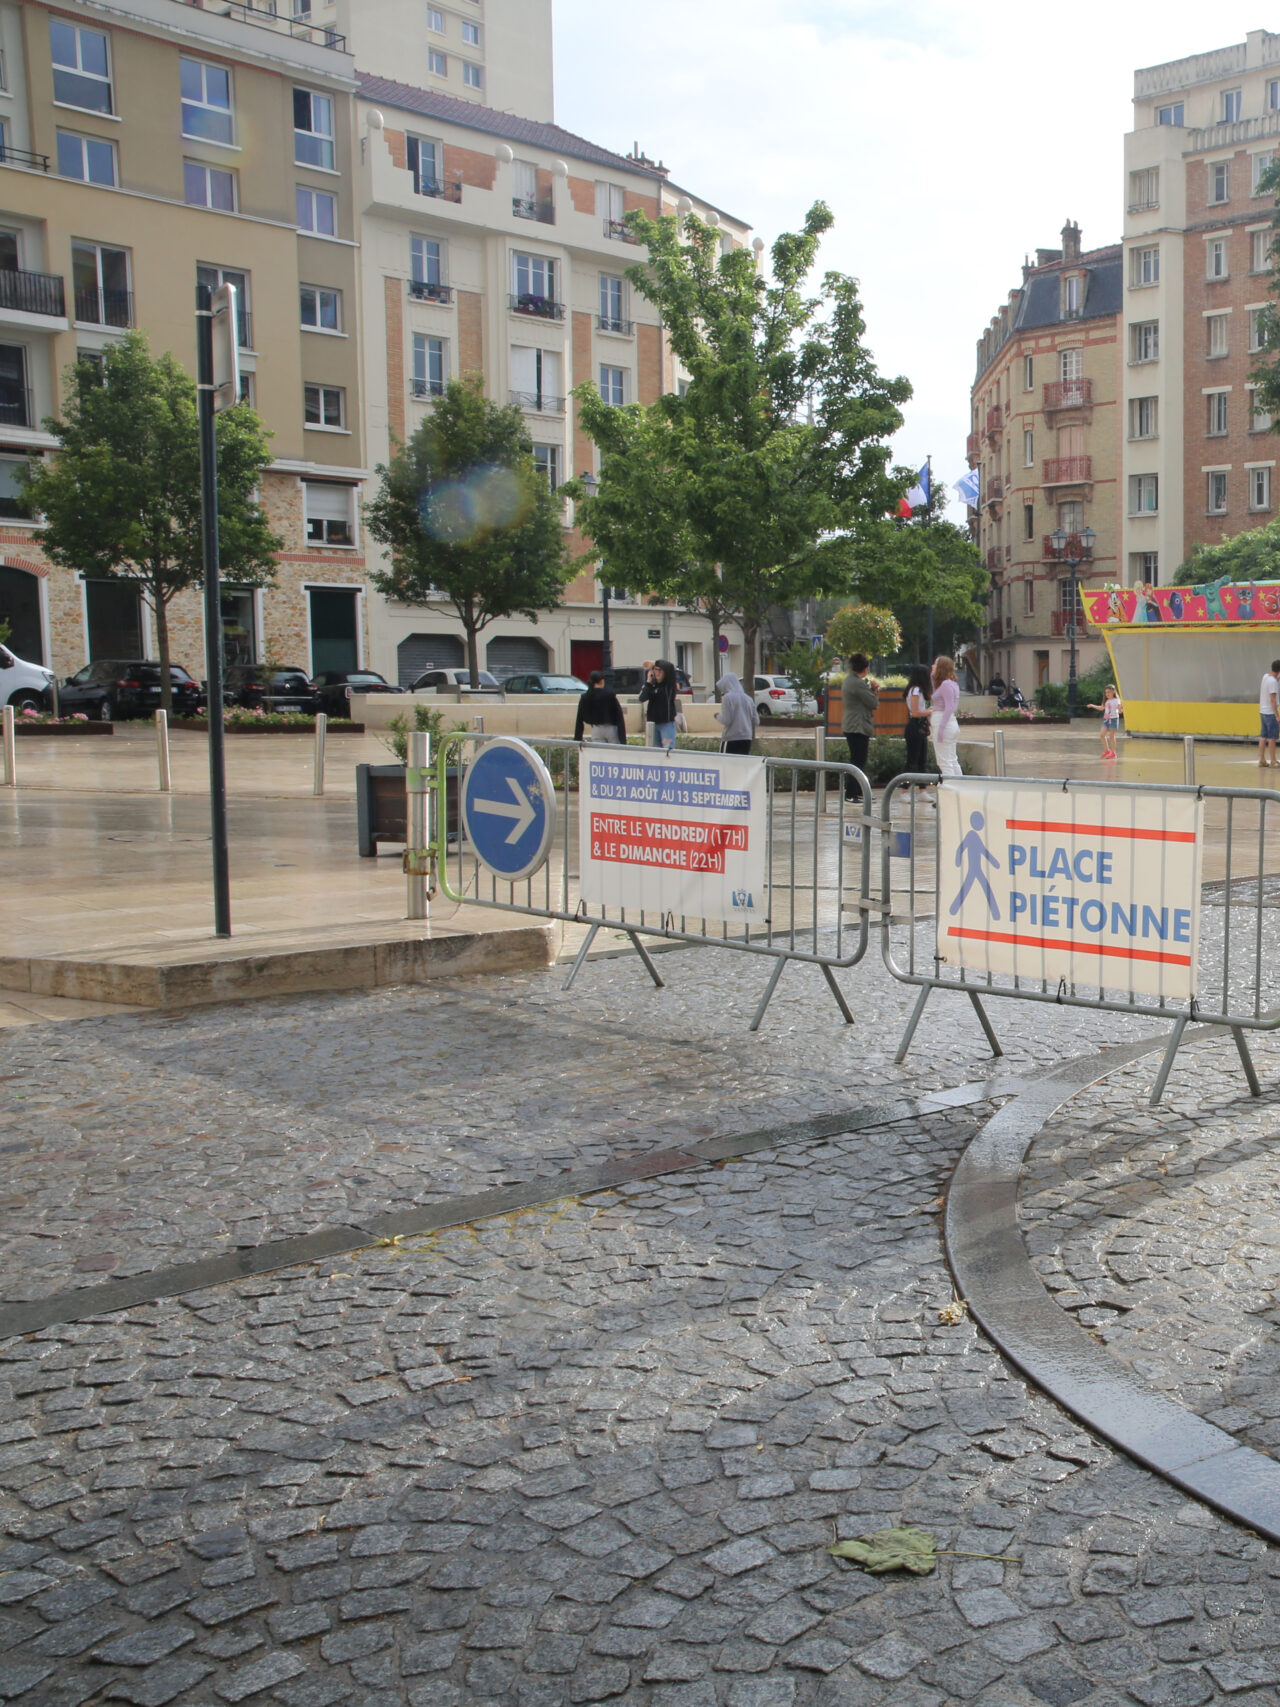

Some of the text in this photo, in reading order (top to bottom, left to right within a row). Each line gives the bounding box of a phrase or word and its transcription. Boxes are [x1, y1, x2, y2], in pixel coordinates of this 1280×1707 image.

[591, 765, 716, 786] DU 19 JUIN AU 19 JUILLET
[592, 783, 749, 808] & DU 21 AOÛT AU 13 SEPTEMBRE
[593, 817, 745, 849] ENTRE LE VENDREDI (17H)
[593, 841, 722, 872] & LE DIMANCHE (22H)
[1008, 844, 1113, 885] PLACE
[1009, 885, 1191, 943] PIÉTONNE
